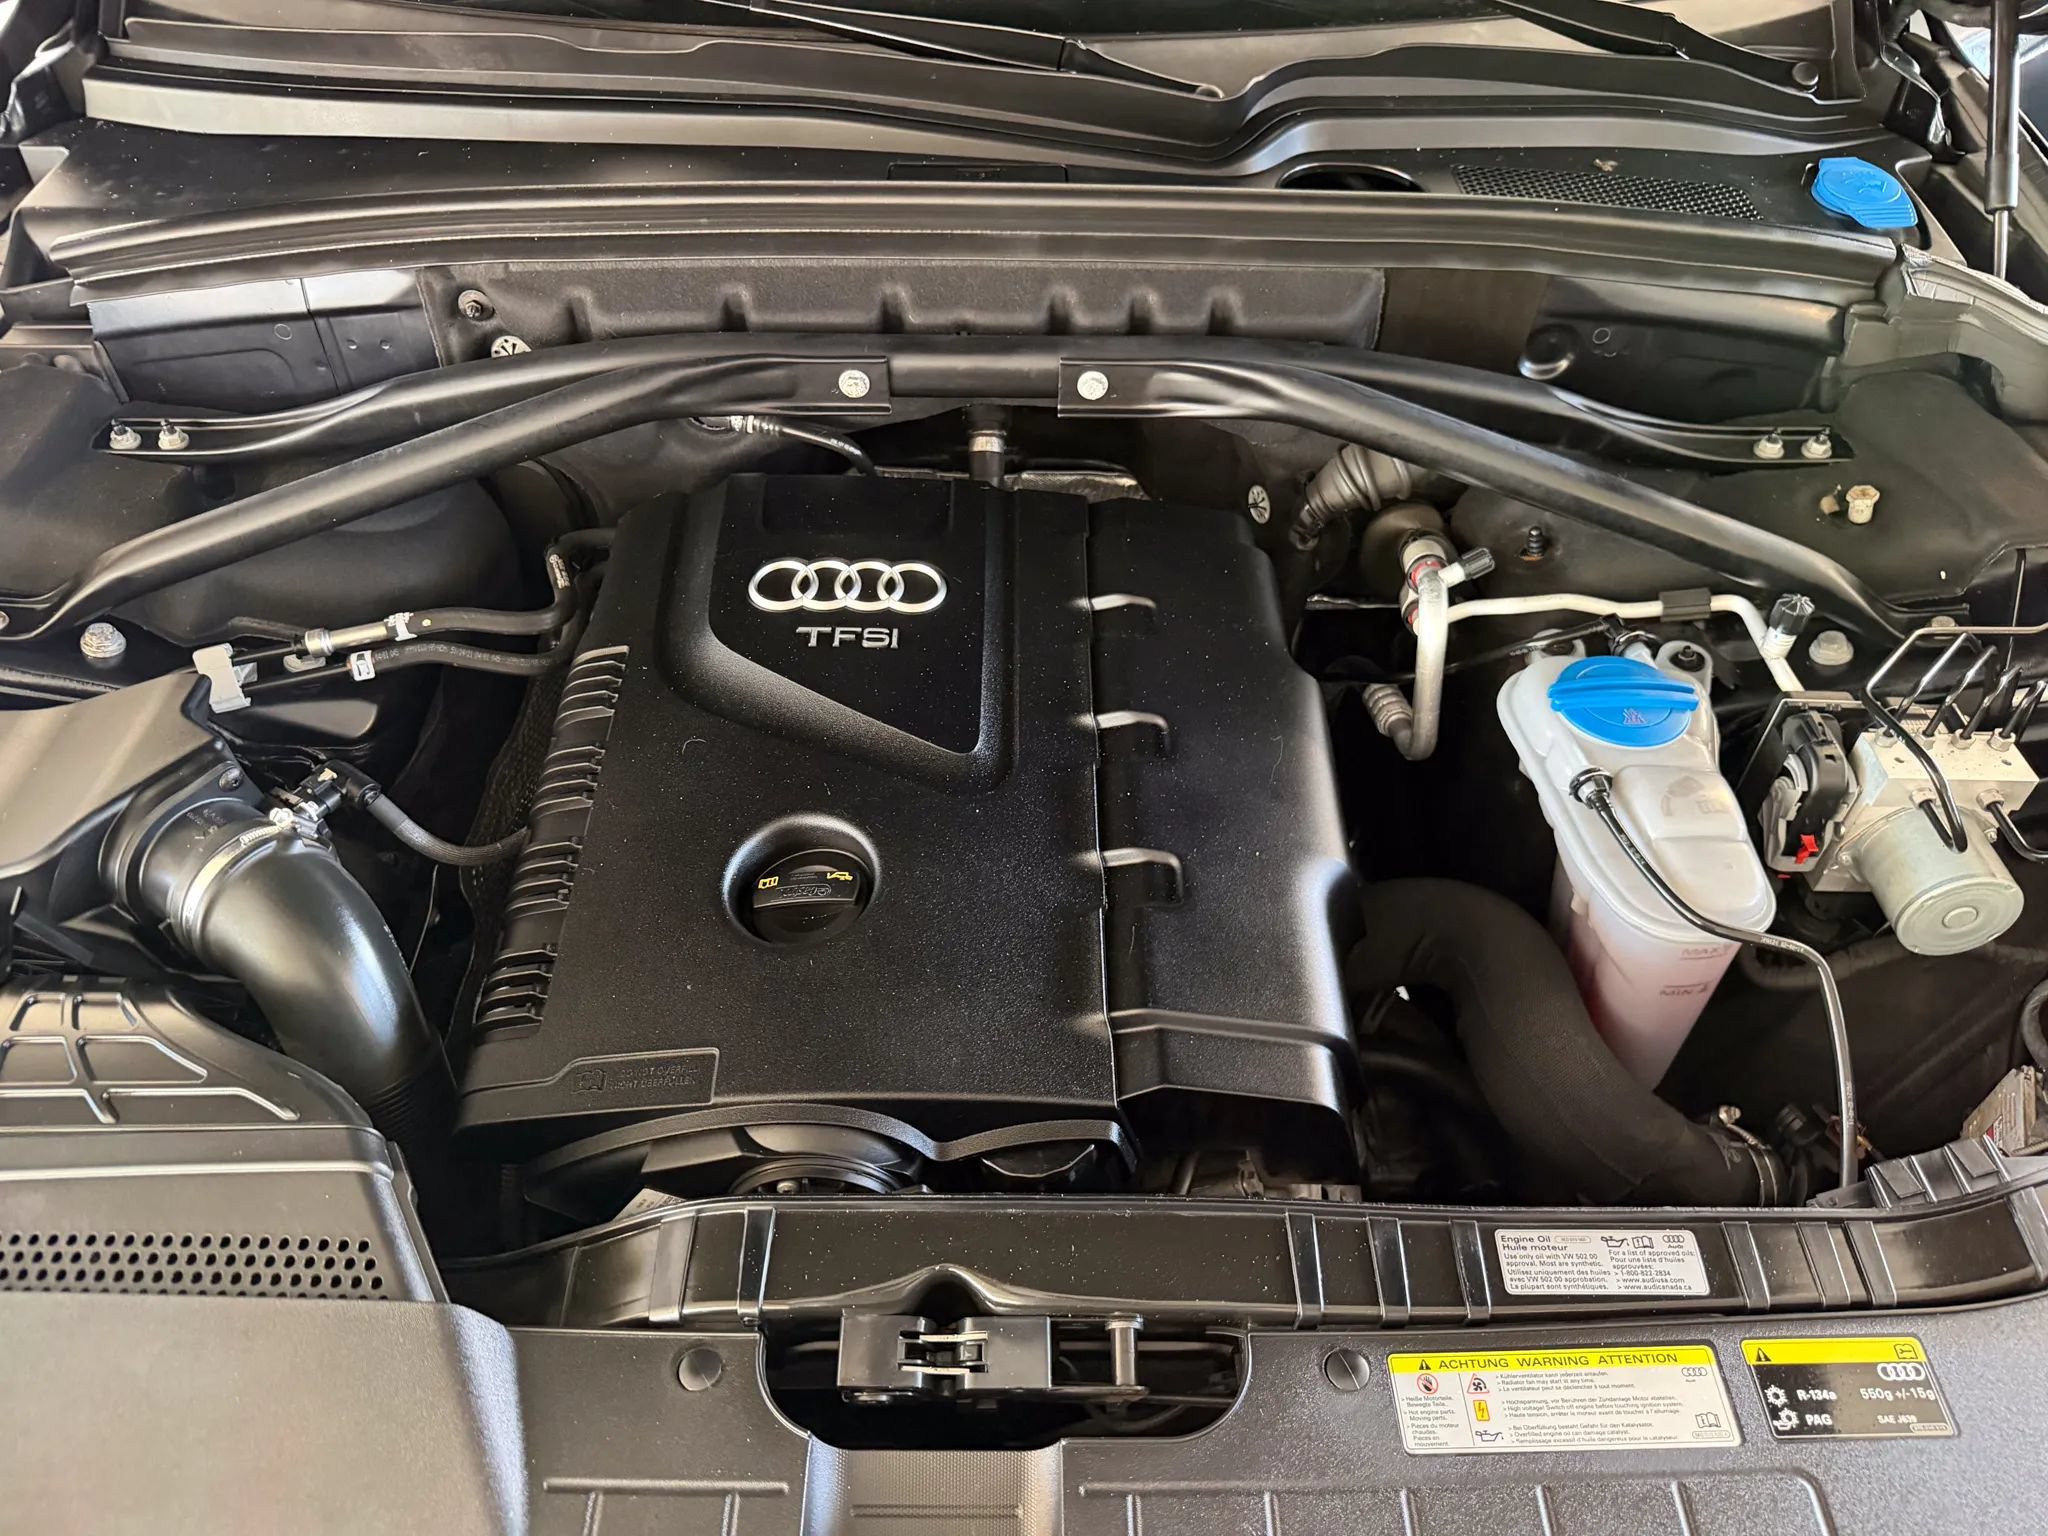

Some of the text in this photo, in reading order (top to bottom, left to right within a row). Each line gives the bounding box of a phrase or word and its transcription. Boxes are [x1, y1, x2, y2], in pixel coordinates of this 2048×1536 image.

[796, 626, 898, 649] TFSI
[1500, 1236, 1534, 1245] Engine
[1519, 1253, 1534, 1261] only
[1506, 1260, 1538, 1268] approval.
[1571, 1260, 1603, 1268] synthetic.
[1533, 1269, 1575, 1277] uniquement
[1564, 1276, 1608, 1284] approbation.
[1563, 1283, 1609, 1291] synthétiques.
[1439, 1353, 1678, 1369] ACHTUNG WARNING ATTENTION
[1796, 1387, 1936, 1401] R-134a 550g +/-15g
[1805, 1413, 1833, 1426] PAG
[1877, 1415, 1896, 1424] SAE
